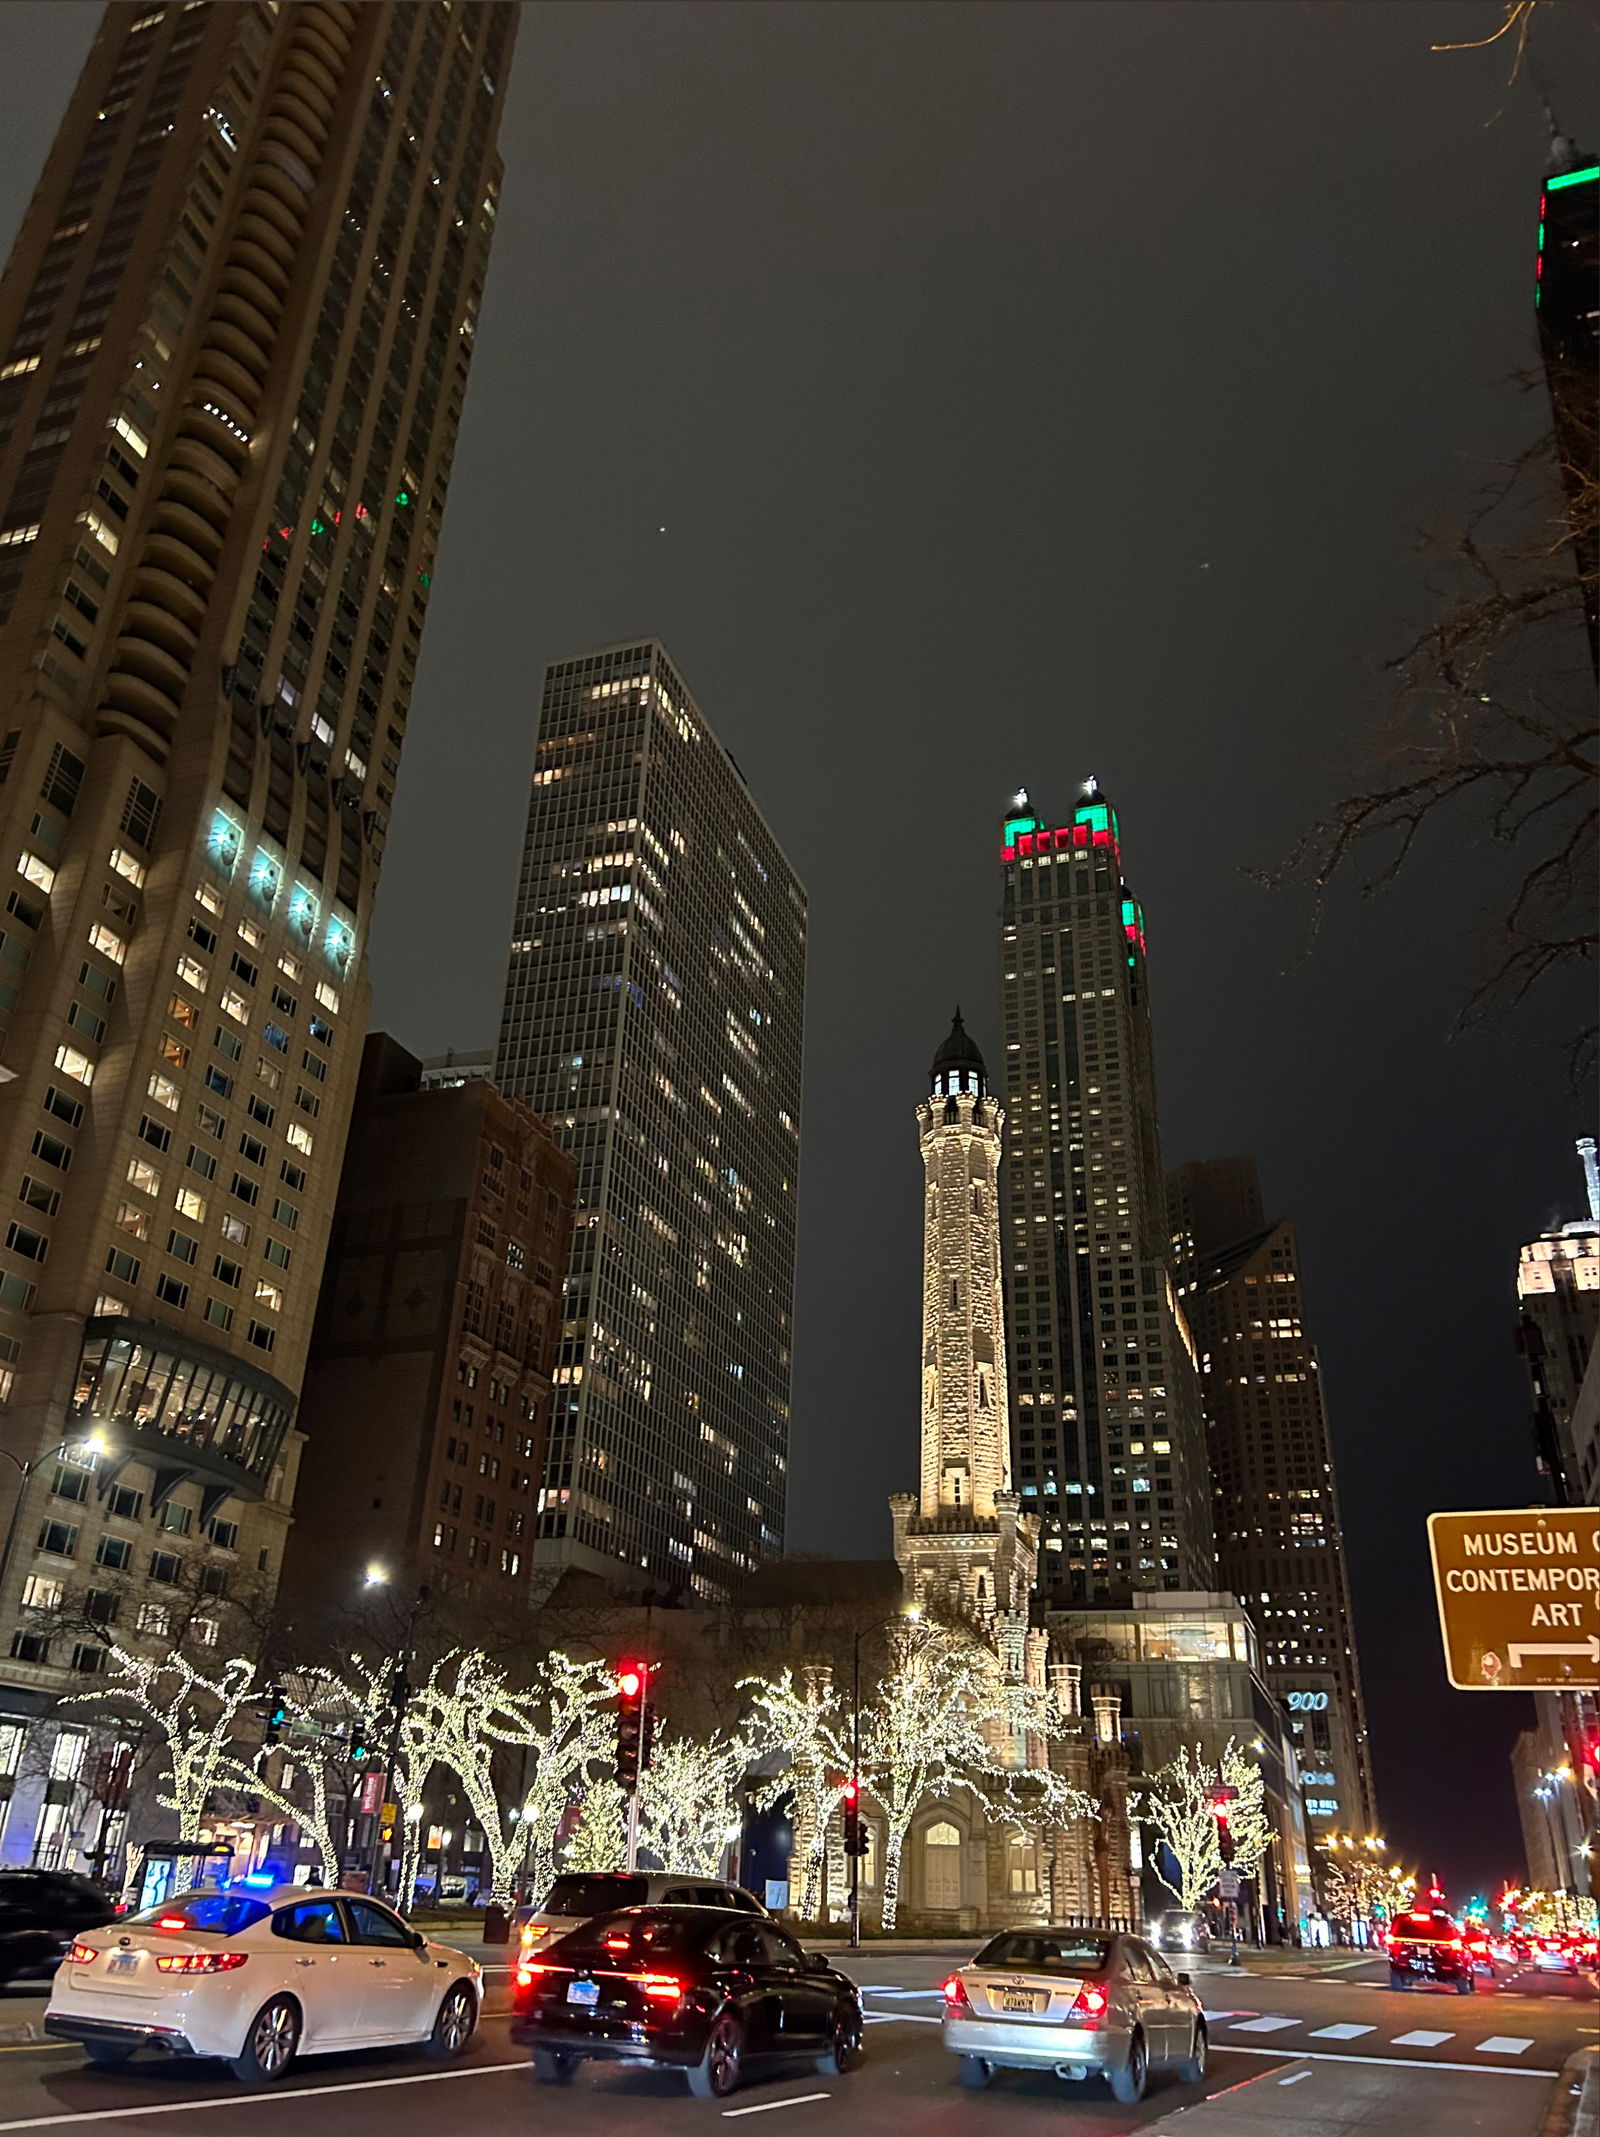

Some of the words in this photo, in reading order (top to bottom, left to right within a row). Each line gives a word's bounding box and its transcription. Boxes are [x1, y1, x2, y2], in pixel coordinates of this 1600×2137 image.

[1463, 1531, 1578, 1556] MUSEUM
[1446, 1567, 1599, 1593] CONTEMPOR
[1531, 1603, 1583, 1627] ART
[1287, 1691, 1329, 1711] 900
